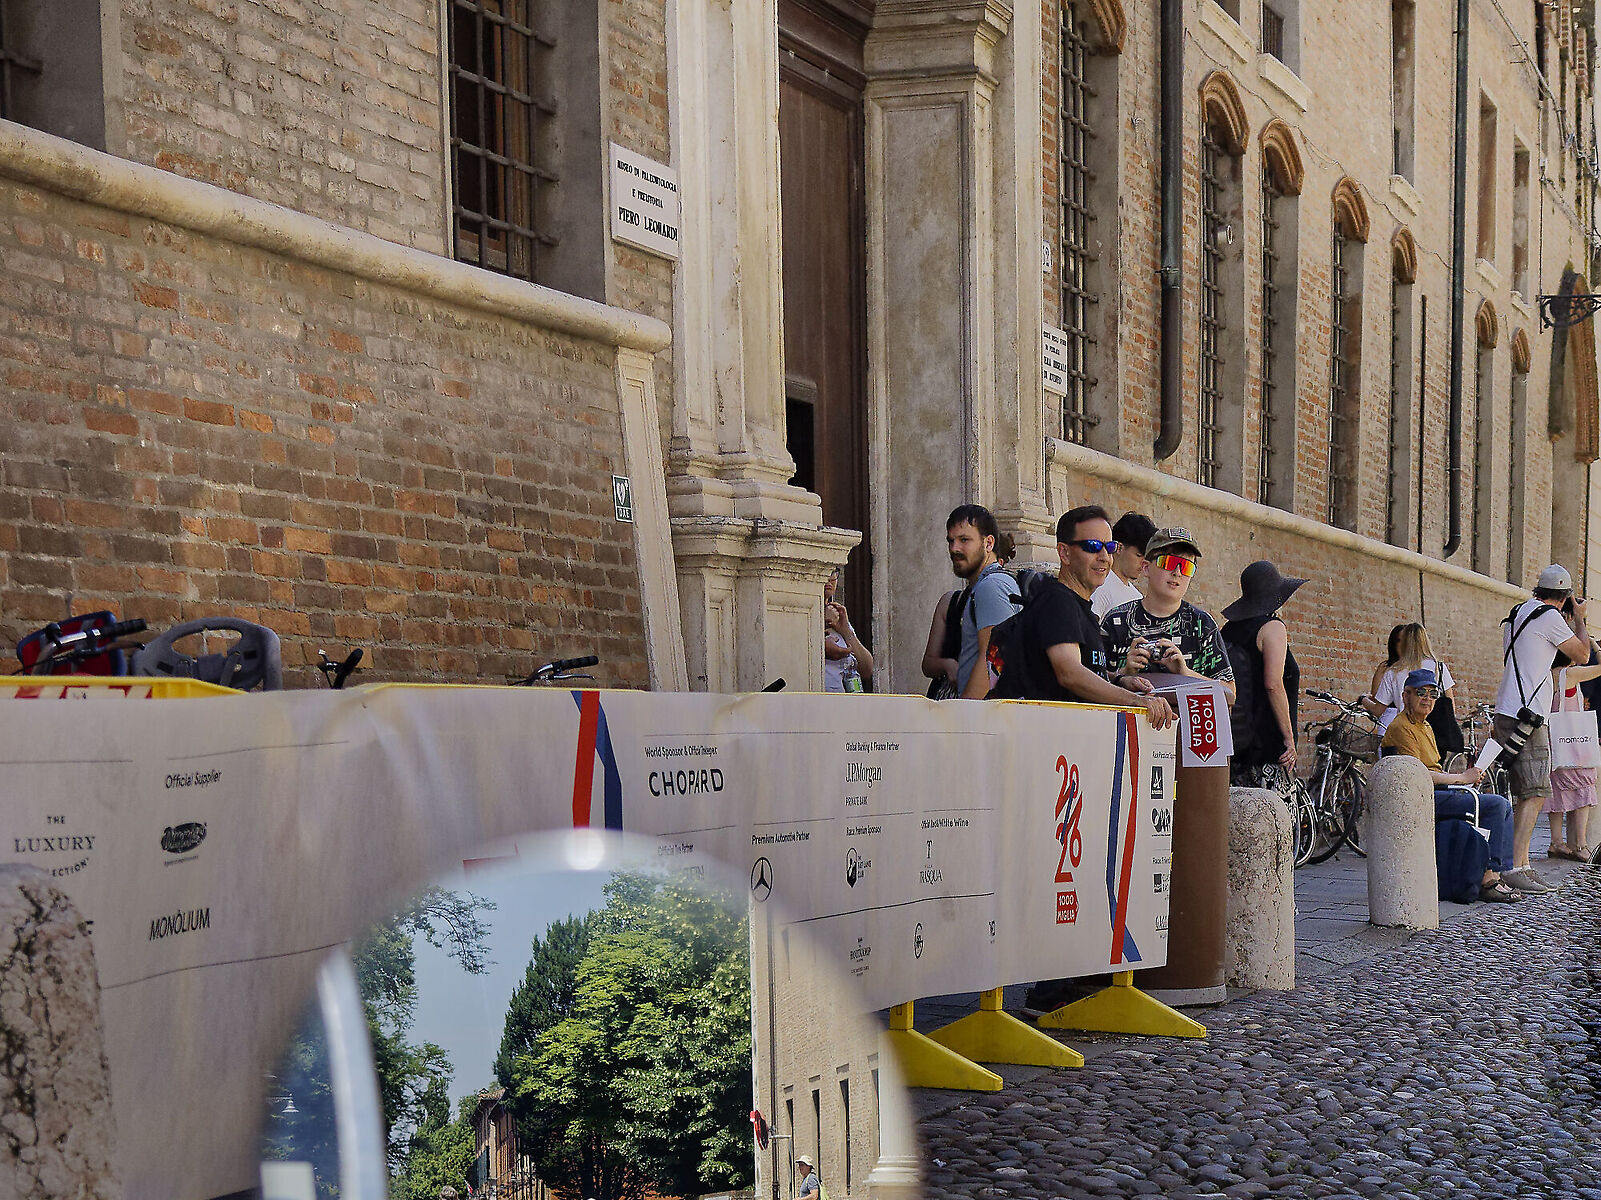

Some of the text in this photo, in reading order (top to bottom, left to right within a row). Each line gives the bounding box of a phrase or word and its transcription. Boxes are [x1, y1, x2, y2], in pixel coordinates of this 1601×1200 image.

[618, 206, 678, 241] PIERO LEONARDI
[1188, 698, 1202, 747] MIGLIA
[1202, 700, 1215, 744] 1000
[165, 769, 223, 789] Official Supplier
[649, 768, 725, 797] CHOPARD
[47, 815, 66, 825] THE
[14, 835, 96, 853] LUXURY
[1058, 894, 1075, 906] 1000
[1057, 909, 1075, 921] MIGLIA
